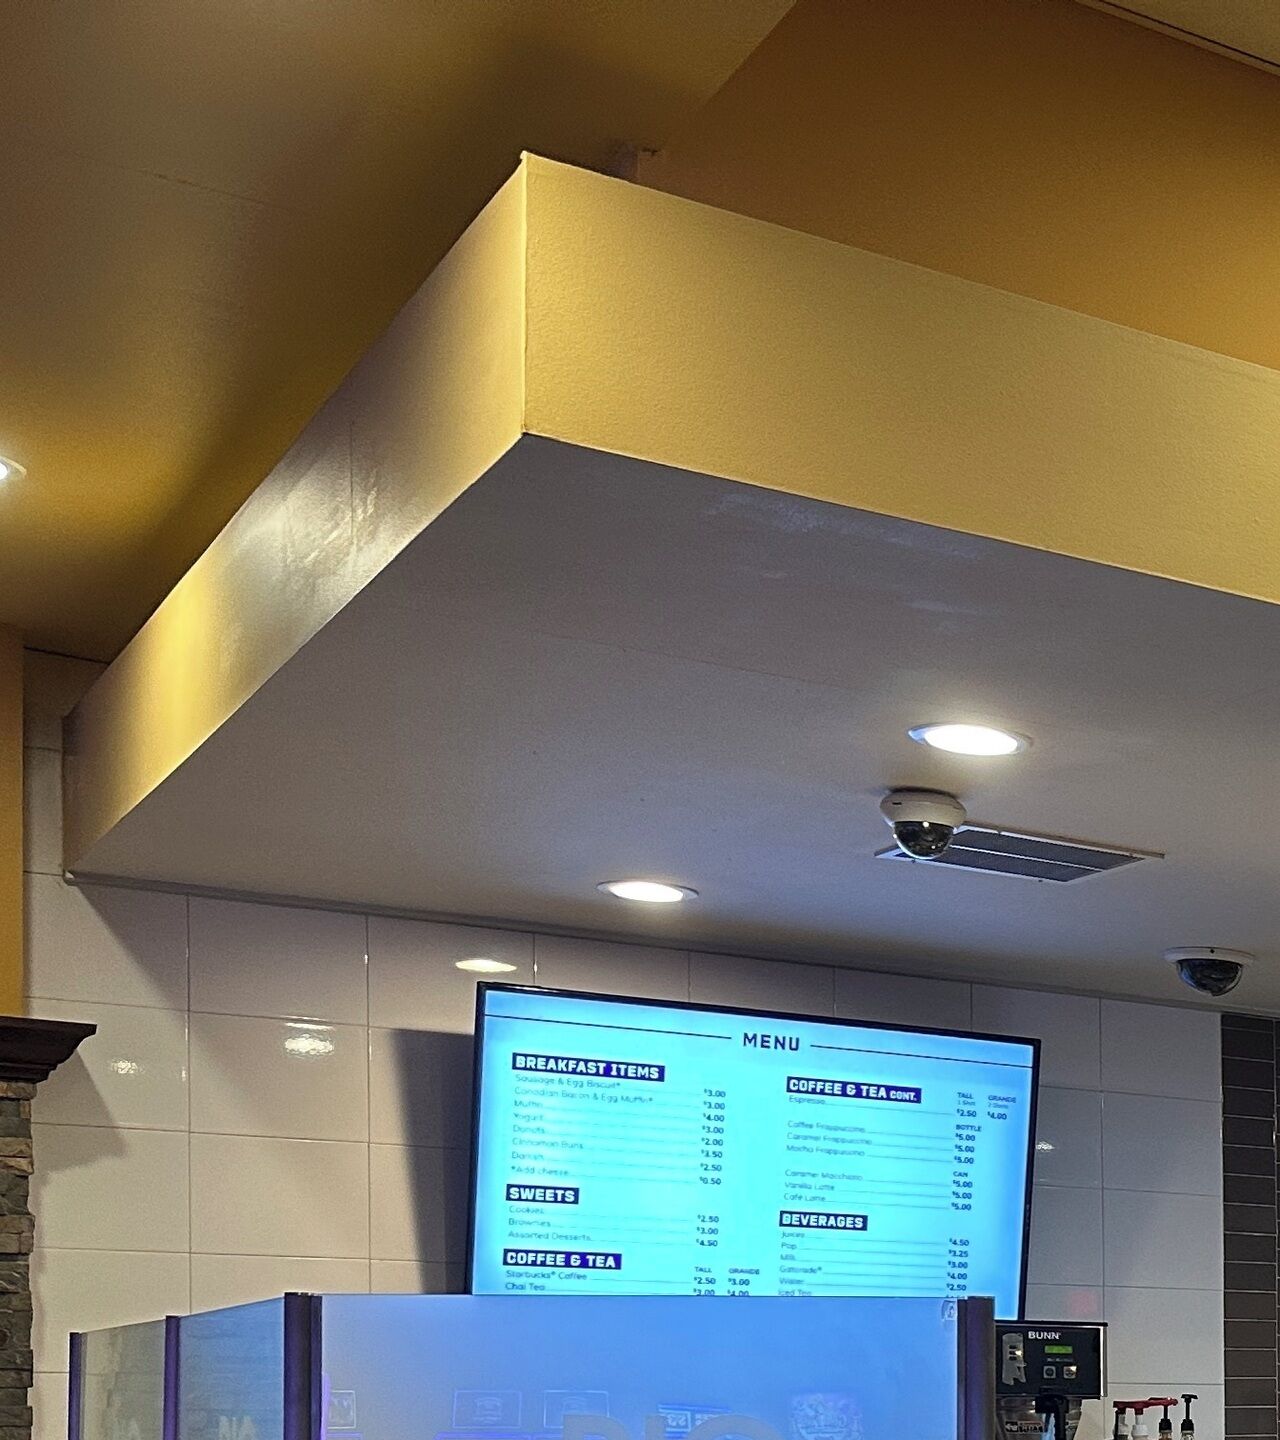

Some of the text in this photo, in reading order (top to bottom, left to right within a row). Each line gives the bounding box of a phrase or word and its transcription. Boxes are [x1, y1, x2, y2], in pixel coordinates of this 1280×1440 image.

[743, 1032, 800, 1051] MENU
[515, 1055, 659, 1079] BREAKFAST ITEMS
[789, 1079, 917, 1101] COFFEE & TEA CONT.
[957, 1108, 977, 1117] $2.50
[701, 1137, 723, 1146] $2.00
[955, 1133, 976, 1141] $5.00
[952, 1179, 973, 1188] $5.00
[509, 1187, 575, 1202] SWEETS
[952, 1190, 972, 1199] $5.00
[951, 1202, 972, 1211] $5.00
[782, 1213, 864, 1229] BEVERAGES
[506, 1252, 615, 1268] COFFEE & TEA
[1028, 1331, 1061, 1340] BUNN
